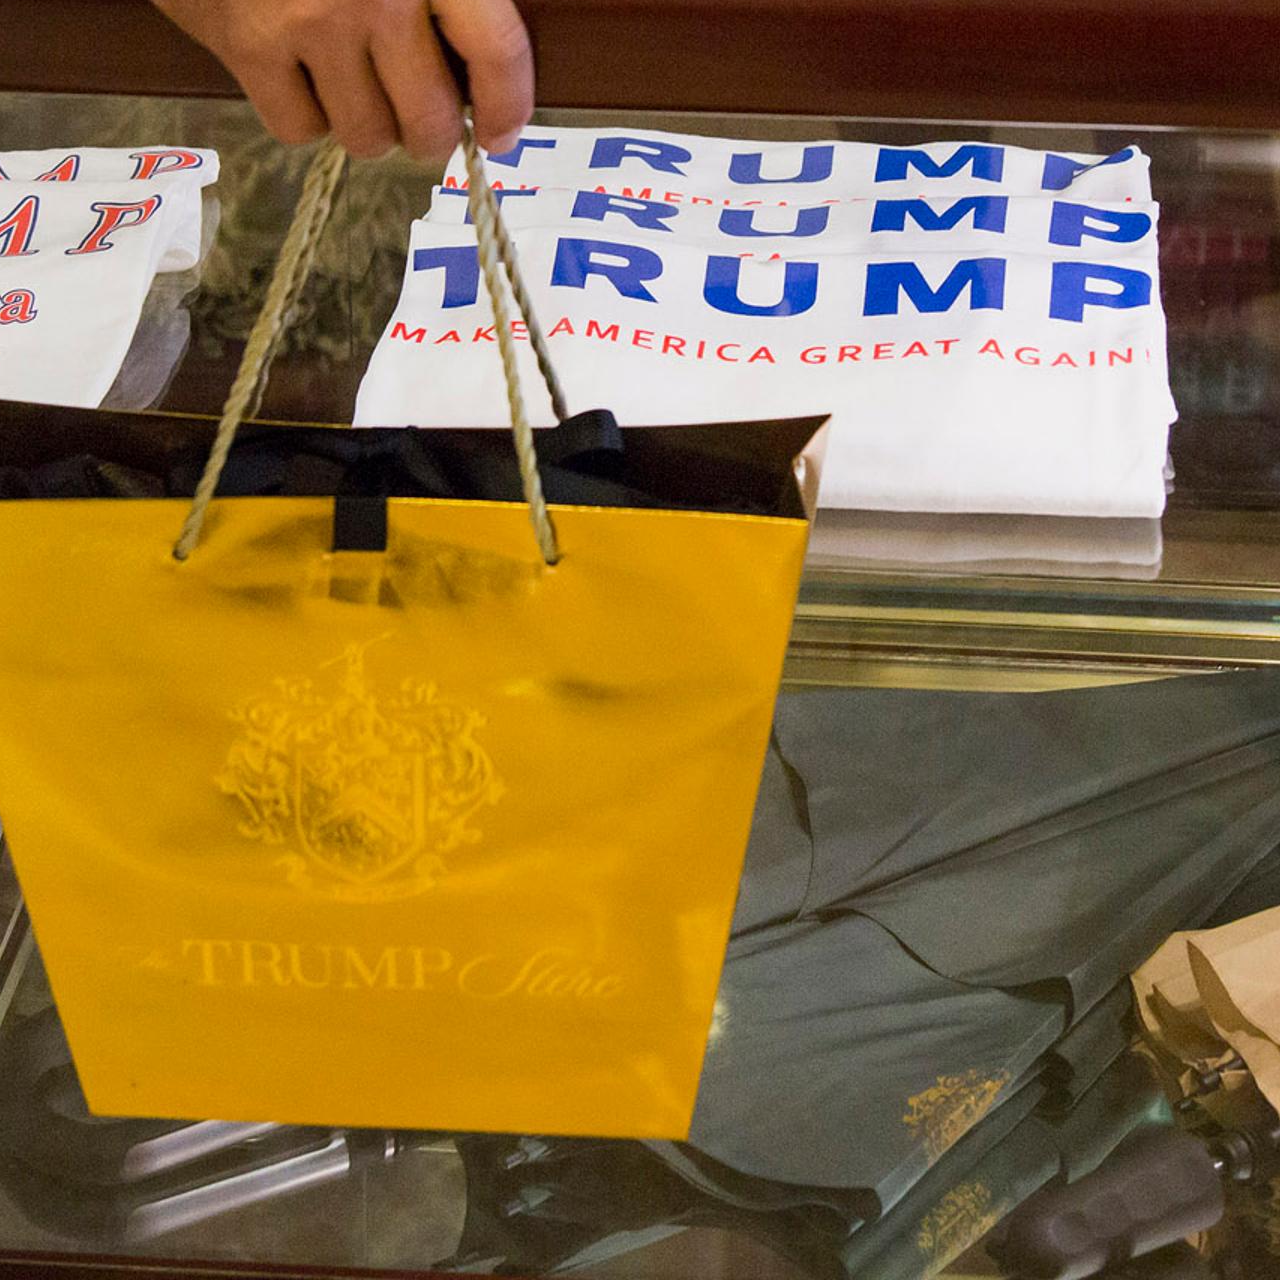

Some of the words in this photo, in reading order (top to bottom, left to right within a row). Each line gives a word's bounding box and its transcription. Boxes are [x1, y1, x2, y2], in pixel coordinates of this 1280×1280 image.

[439, 186, 1152, 247] TRUMP
[413, 236, 1152, 323] TRUMP
[390, 320, 528, 345] MAKE
[548, 316, 776, 365] AMERICA
[800, 338, 960, 365] GREAT
[977, 338, 1150, 368] AGAIN!
[181, 939, 454, 991] TRUMP
[458, 947, 621, 999] Store
